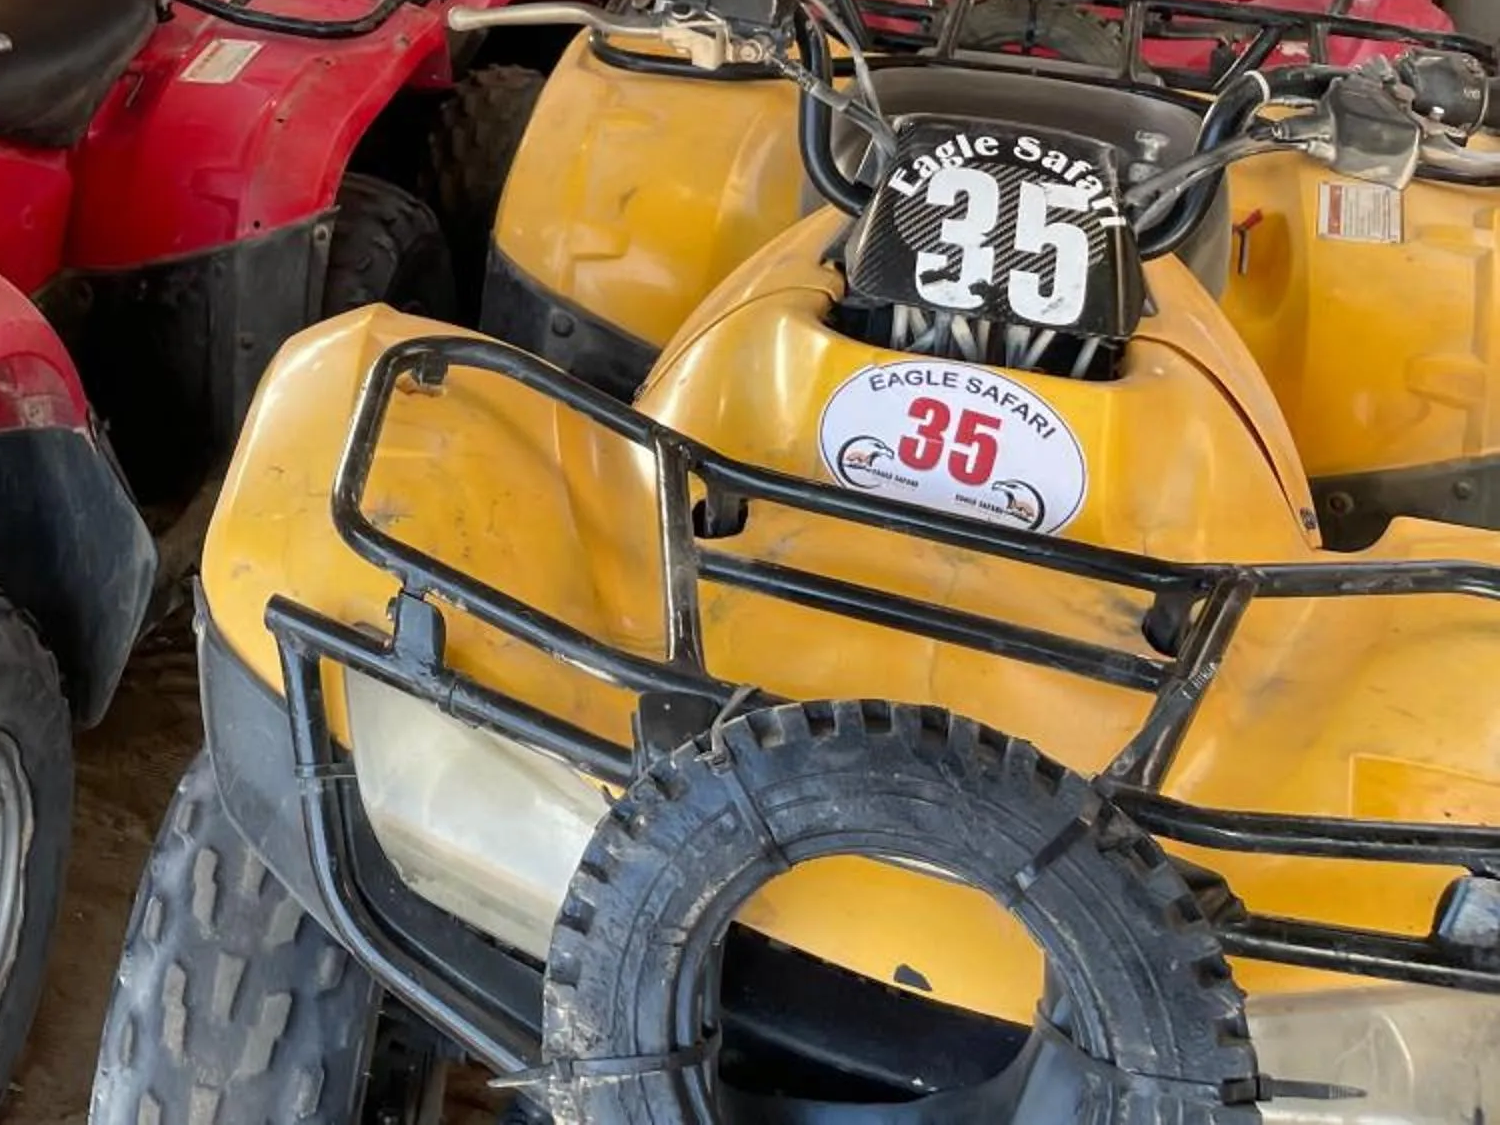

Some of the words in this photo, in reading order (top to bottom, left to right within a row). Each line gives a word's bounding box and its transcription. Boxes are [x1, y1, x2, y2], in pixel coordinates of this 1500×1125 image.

[888, 133, 1000, 198] Eagle
[1013, 135, 1127, 227] Safari
[915, 166, 1089, 326] 35
[868, 370, 961, 393] EAGLE
[965, 378, 1057, 440] SAFARI
[897, 396, 1002, 487] 35
